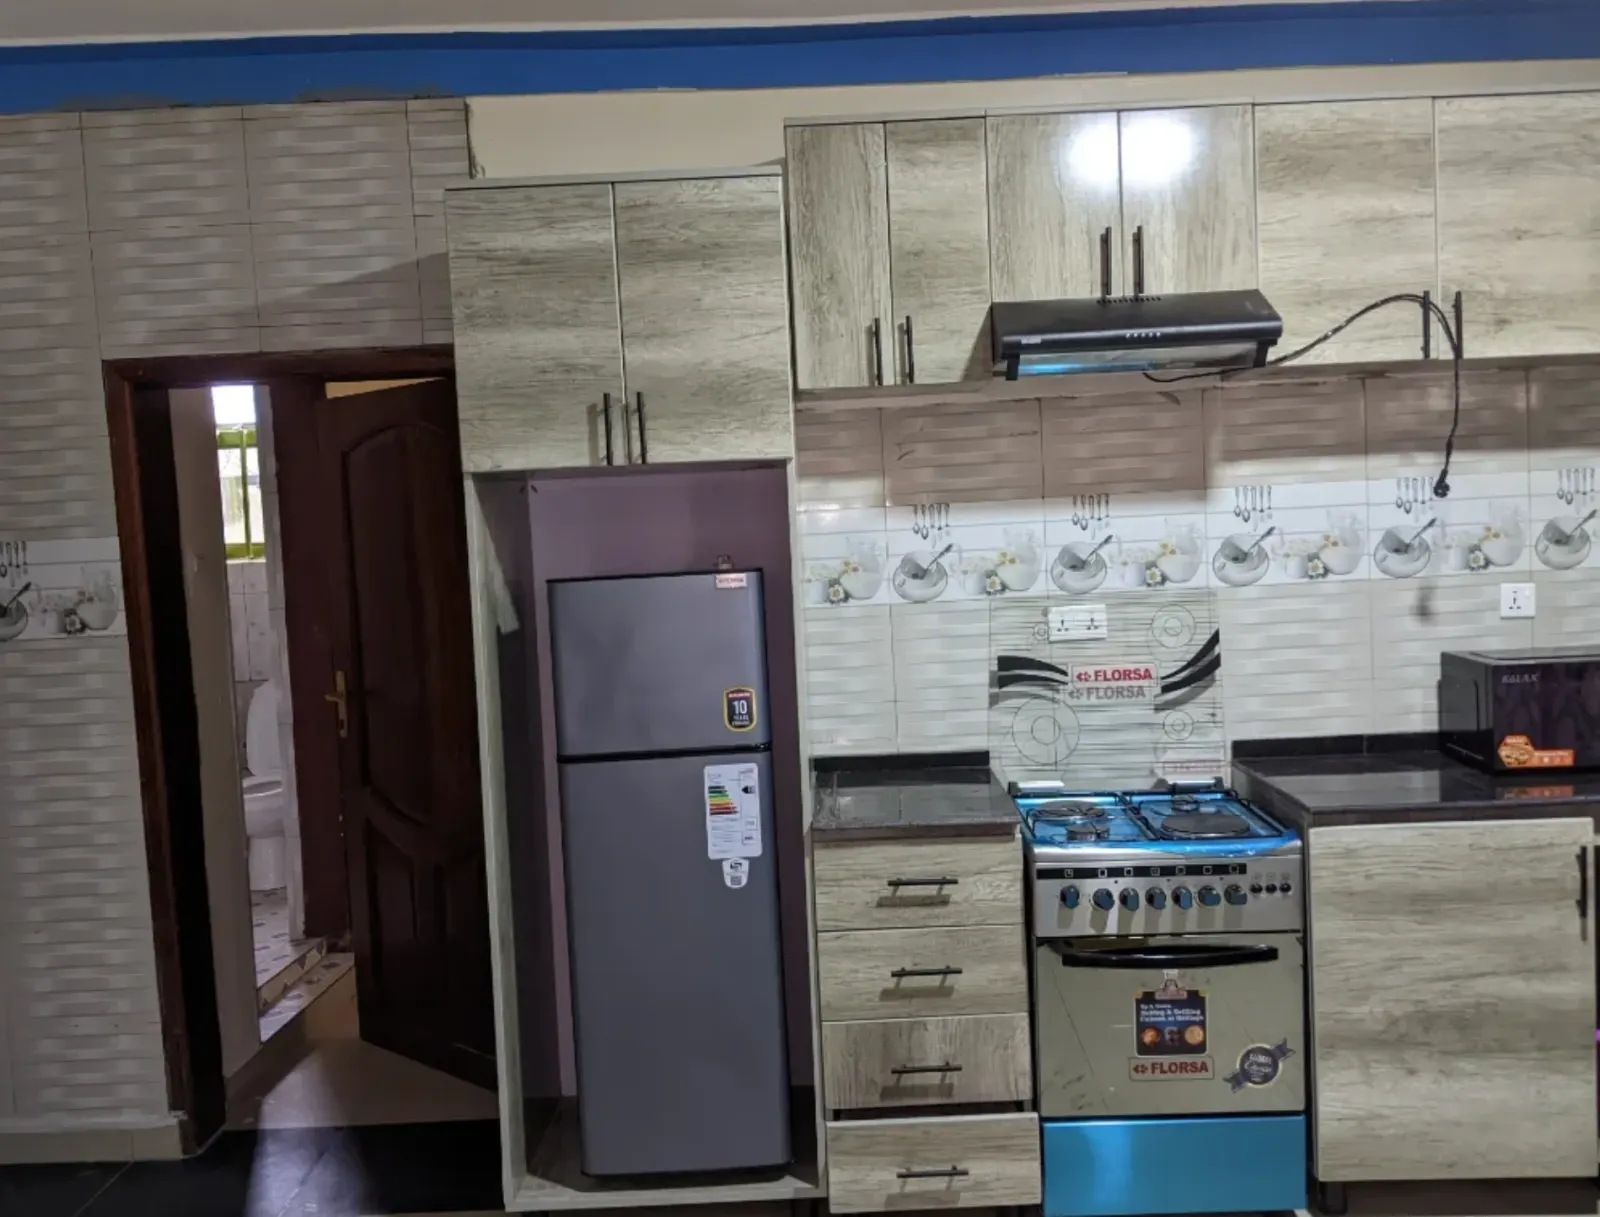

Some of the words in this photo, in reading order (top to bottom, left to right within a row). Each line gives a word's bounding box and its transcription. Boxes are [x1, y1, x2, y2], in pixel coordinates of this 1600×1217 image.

[1093, 667, 1153, 682] FLORSA
[1086, 685, 1147, 700] FLORSA
[731, 700, 748, 714] 10
[1150, 1061, 1209, 1075] FLORSA
